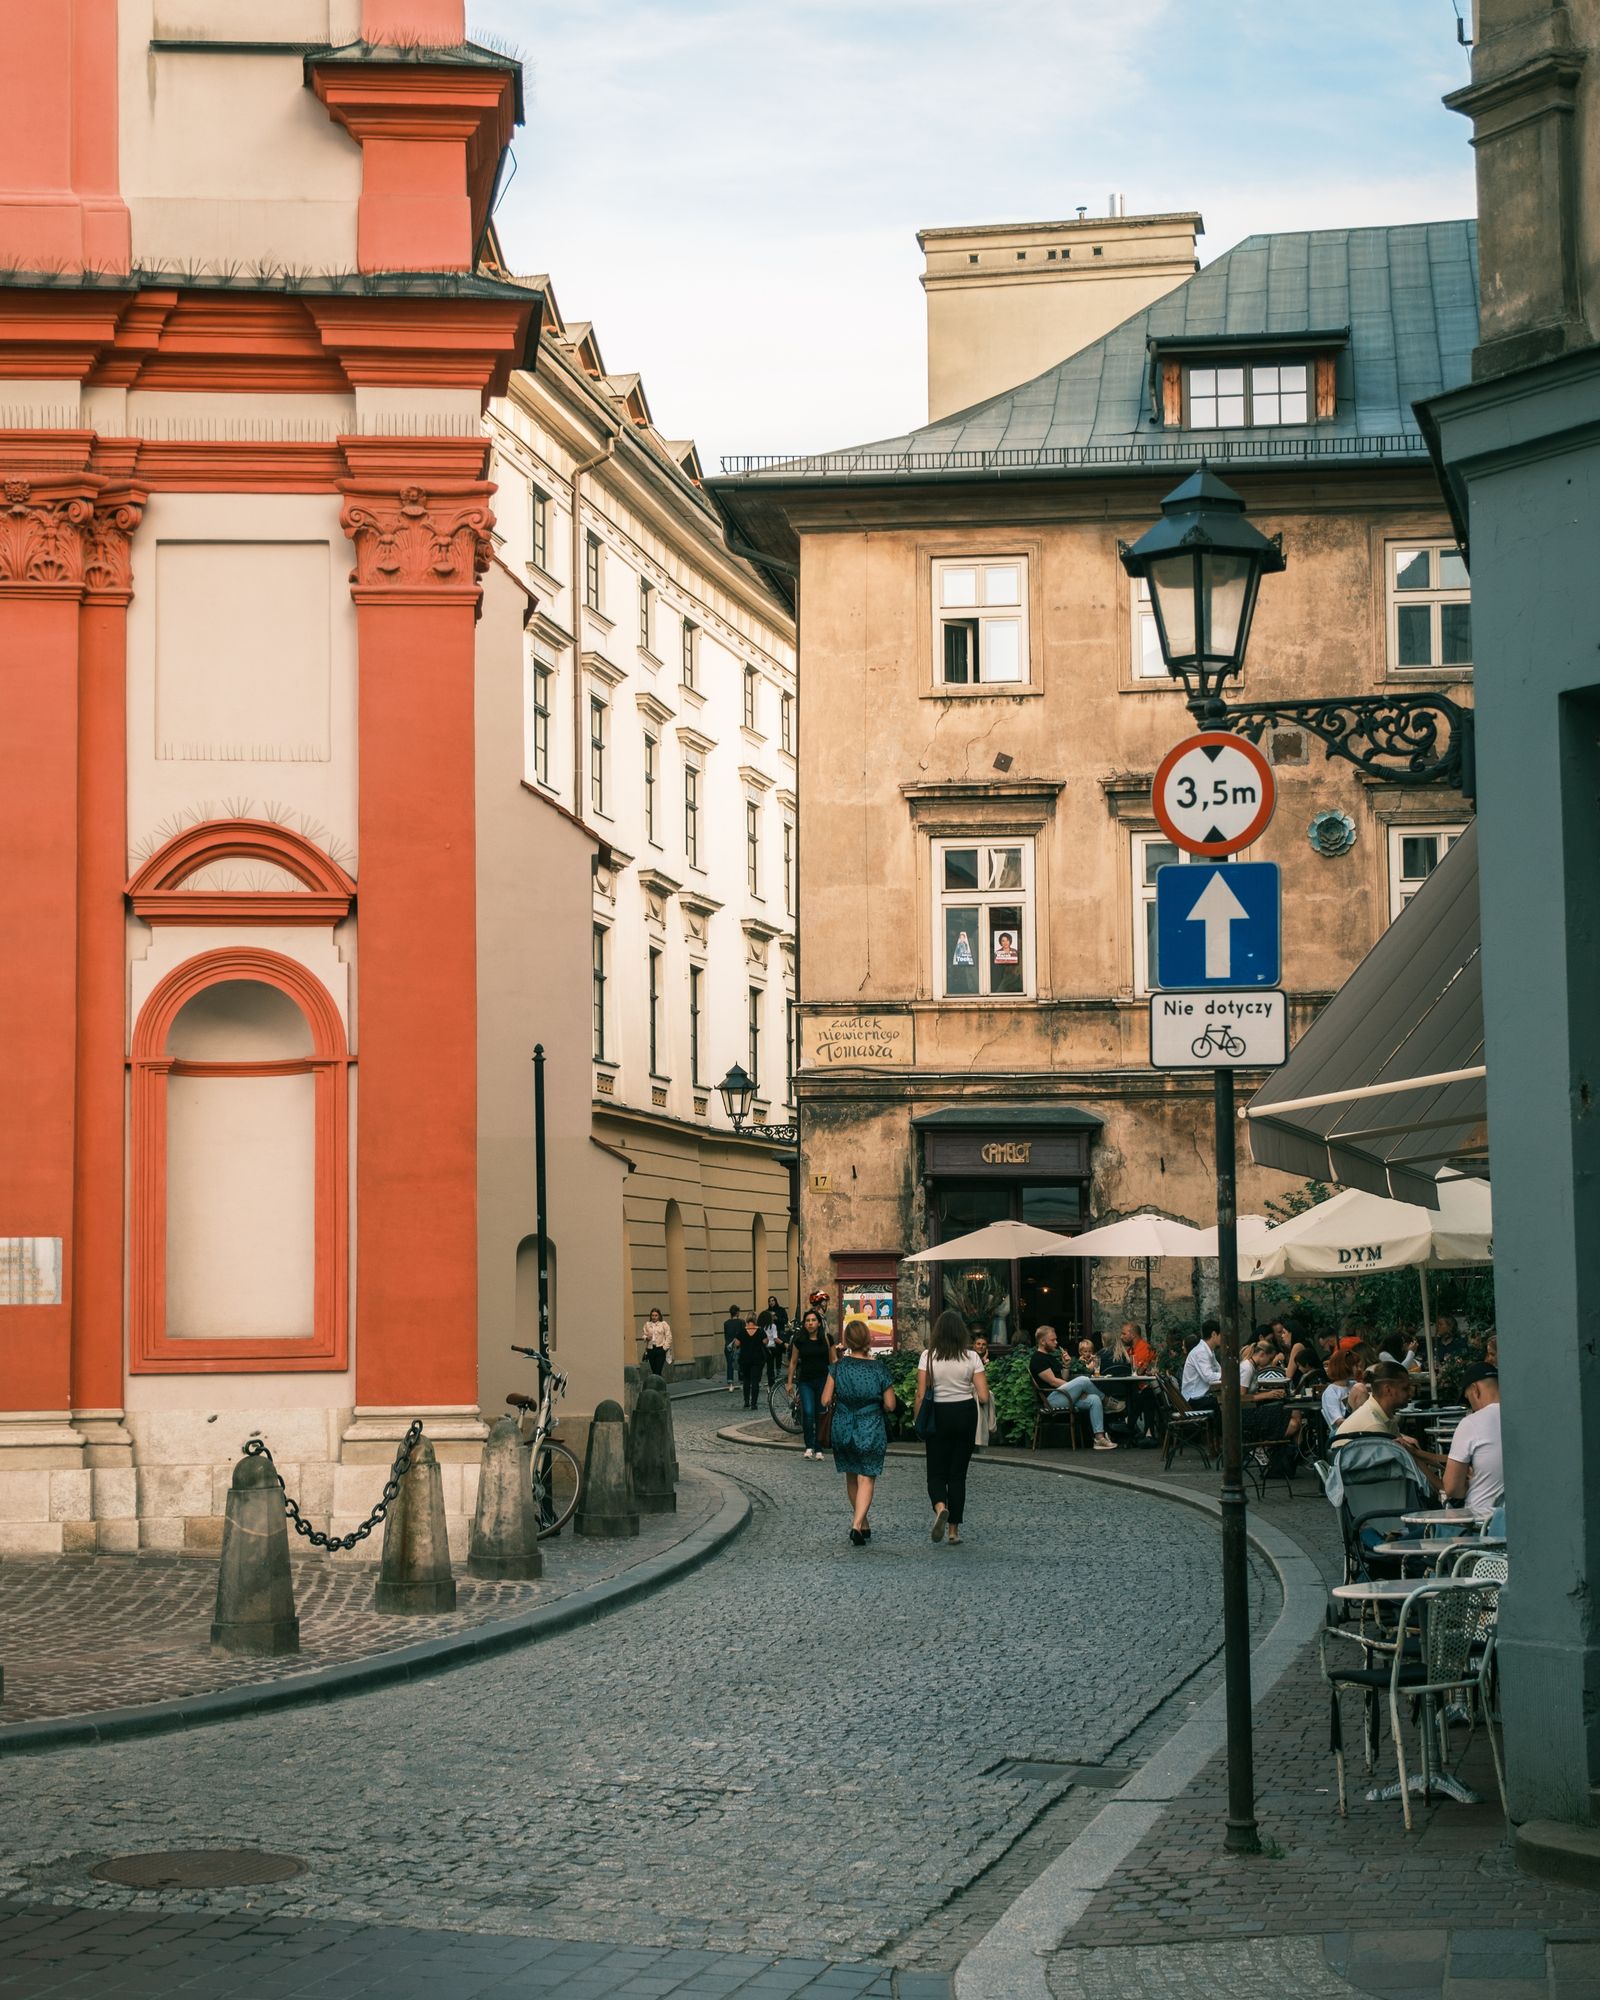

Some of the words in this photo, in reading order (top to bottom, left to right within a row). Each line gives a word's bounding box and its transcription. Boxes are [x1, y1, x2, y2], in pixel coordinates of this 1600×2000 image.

[1176, 776, 1256, 812] 3,5m
[1163, 1000, 1194, 1016] Nie
[1204, 1000, 1273, 1019] dotyczy
[818, 1028, 900, 1044] niewiernego
[816, 1041, 893, 1063] Tomasza
[981, 1142, 1033, 1164] CAMELOT
[815, 1176, 827, 1186] 17
[1337, 1245, 1382, 1264] DYM
